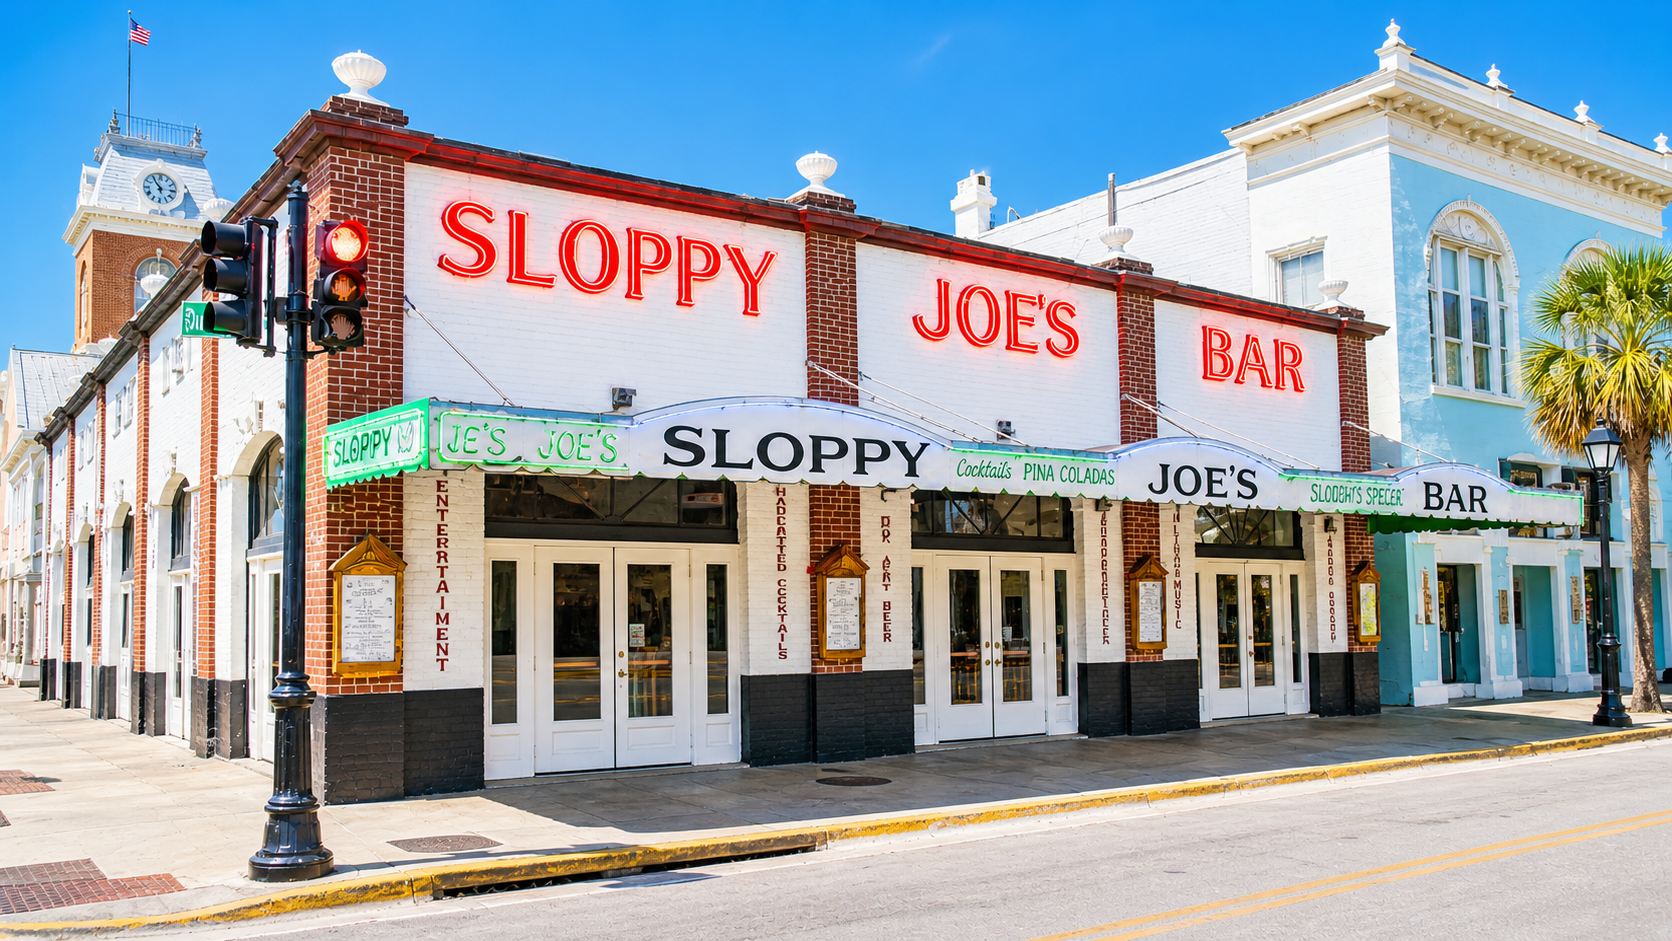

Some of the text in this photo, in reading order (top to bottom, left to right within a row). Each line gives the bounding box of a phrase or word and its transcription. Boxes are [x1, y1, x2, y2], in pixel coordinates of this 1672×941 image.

[437, 199, 779, 317] SLOPPY
[912, 278, 1081, 358] JOE'S
[1201, 325, 1306, 393] BAR
[333, 426, 392, 468] SLOPPY
[537, 429, 619, 463] JOE'S
[663, 425, 930, 478] SLOPPY
[1023, 463, 1115, 485] PINA COLADAS
[1148, 463, 1258, 500] JOE'S
[1423, 481, 1488, 514] BAR
[882, 600, 892, 643] BEER
[1173, 579, 1182, 630] MUSIC
